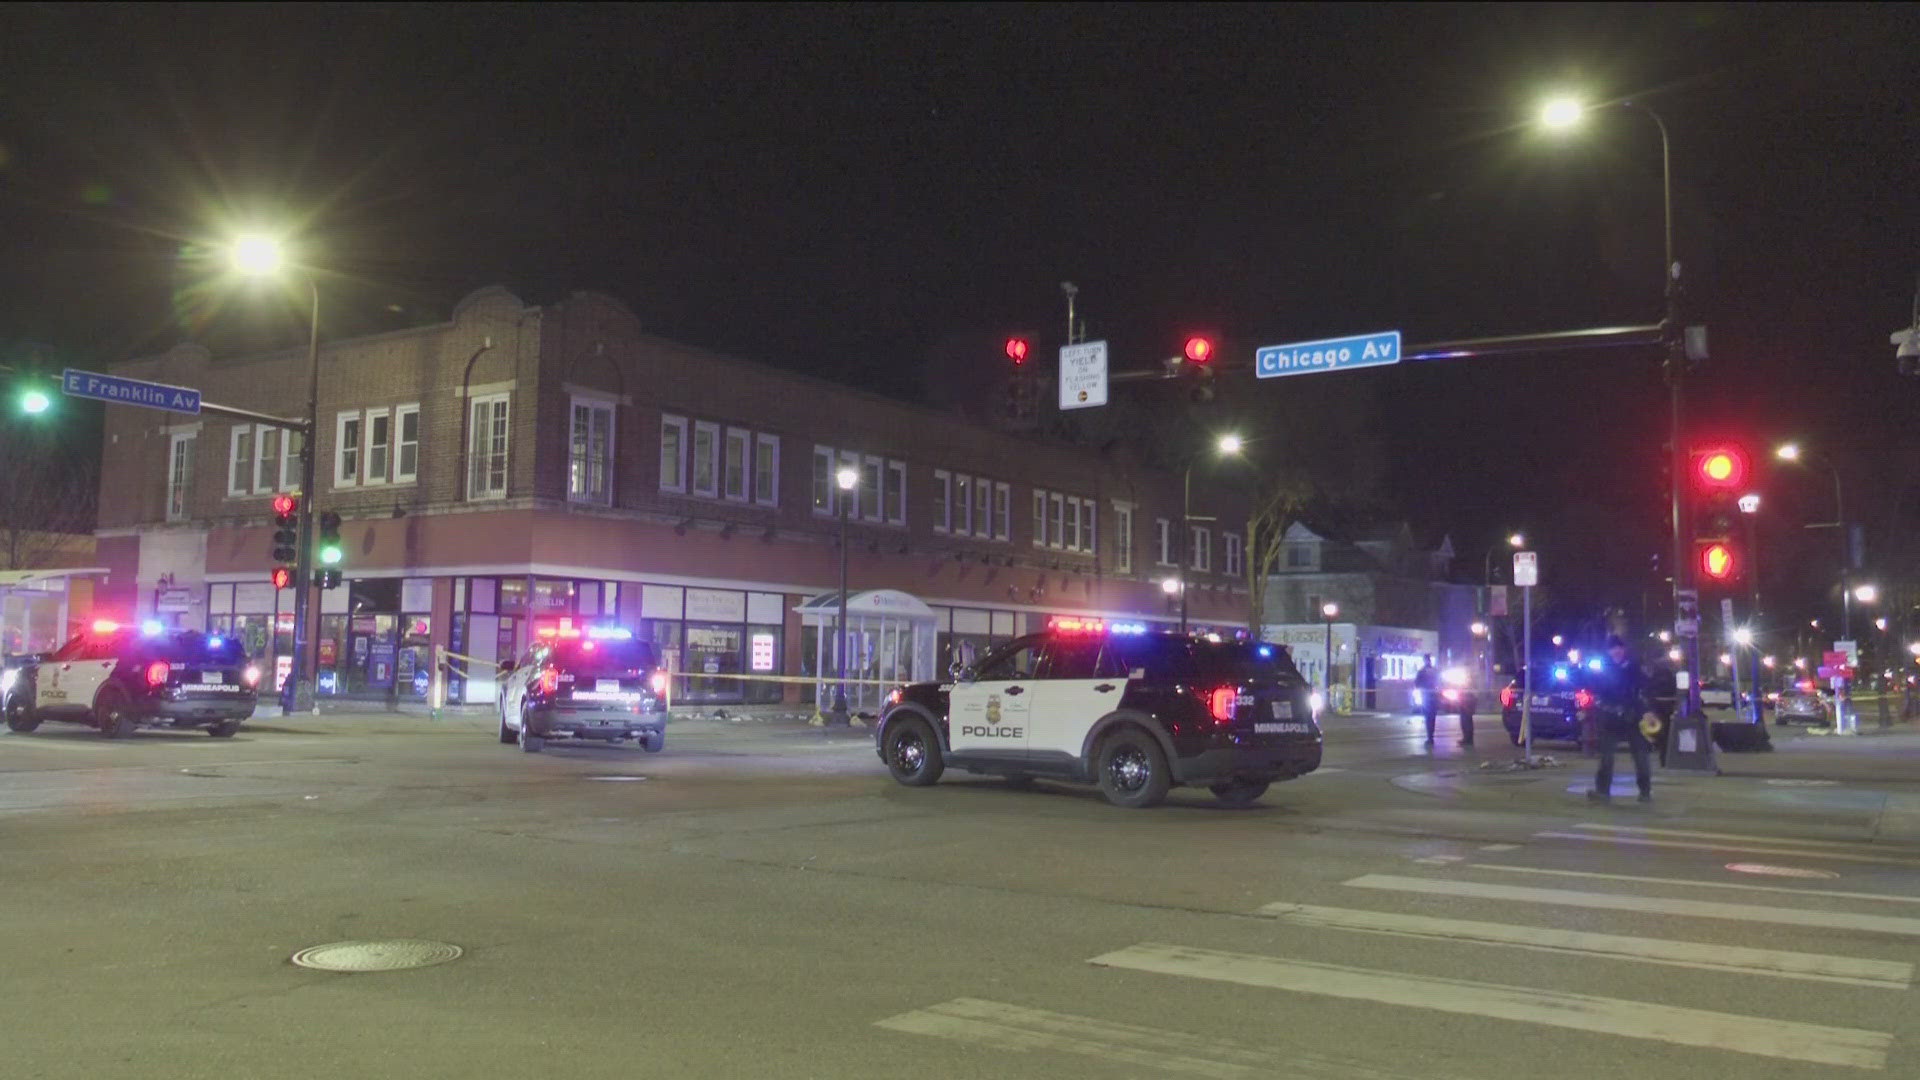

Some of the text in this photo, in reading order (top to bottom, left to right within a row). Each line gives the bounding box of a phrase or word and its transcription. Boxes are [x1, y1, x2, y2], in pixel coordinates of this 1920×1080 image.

[1262, 340, 1392, 370] Chicago Av
[69, 376, 195, 408] E Franklin Av
[181, 683, 240, 692] MINNEAPOLIS
[1236, 695, 1254, 706] 332
[961, 725, 1024, 738] POLICE
